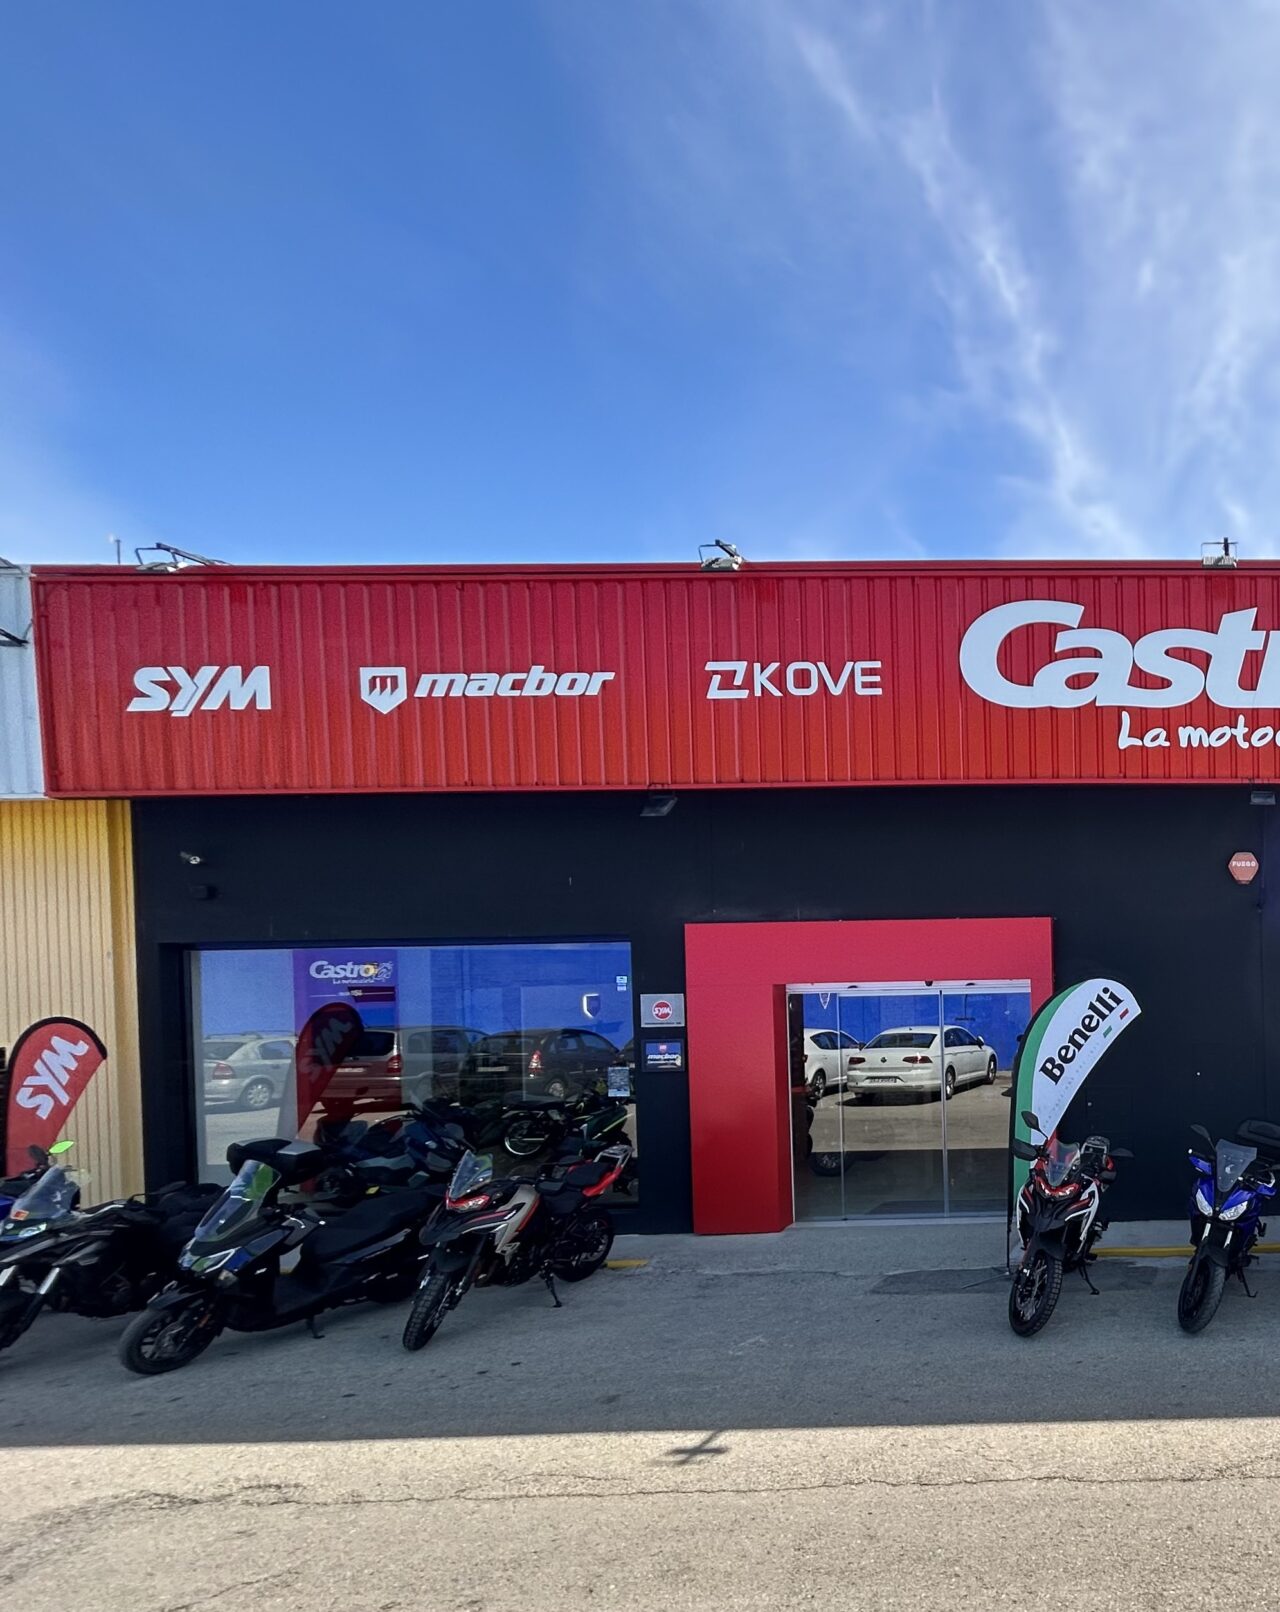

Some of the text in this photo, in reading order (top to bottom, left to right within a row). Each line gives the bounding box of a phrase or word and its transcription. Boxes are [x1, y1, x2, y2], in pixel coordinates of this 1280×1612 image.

[127, 666, 271, 716] SYM
[414, 665, 616, 697] macbor
[753, 660, 882, 697] KOVE
[1118, 711, 1170, 750] La
[309, 960, 375, 979] Castro
[653, 1006, 673, 1016] SYM
[1039, 986, 1124, 1086] Benelli
[16, 1035, 89, 1120] SYM
